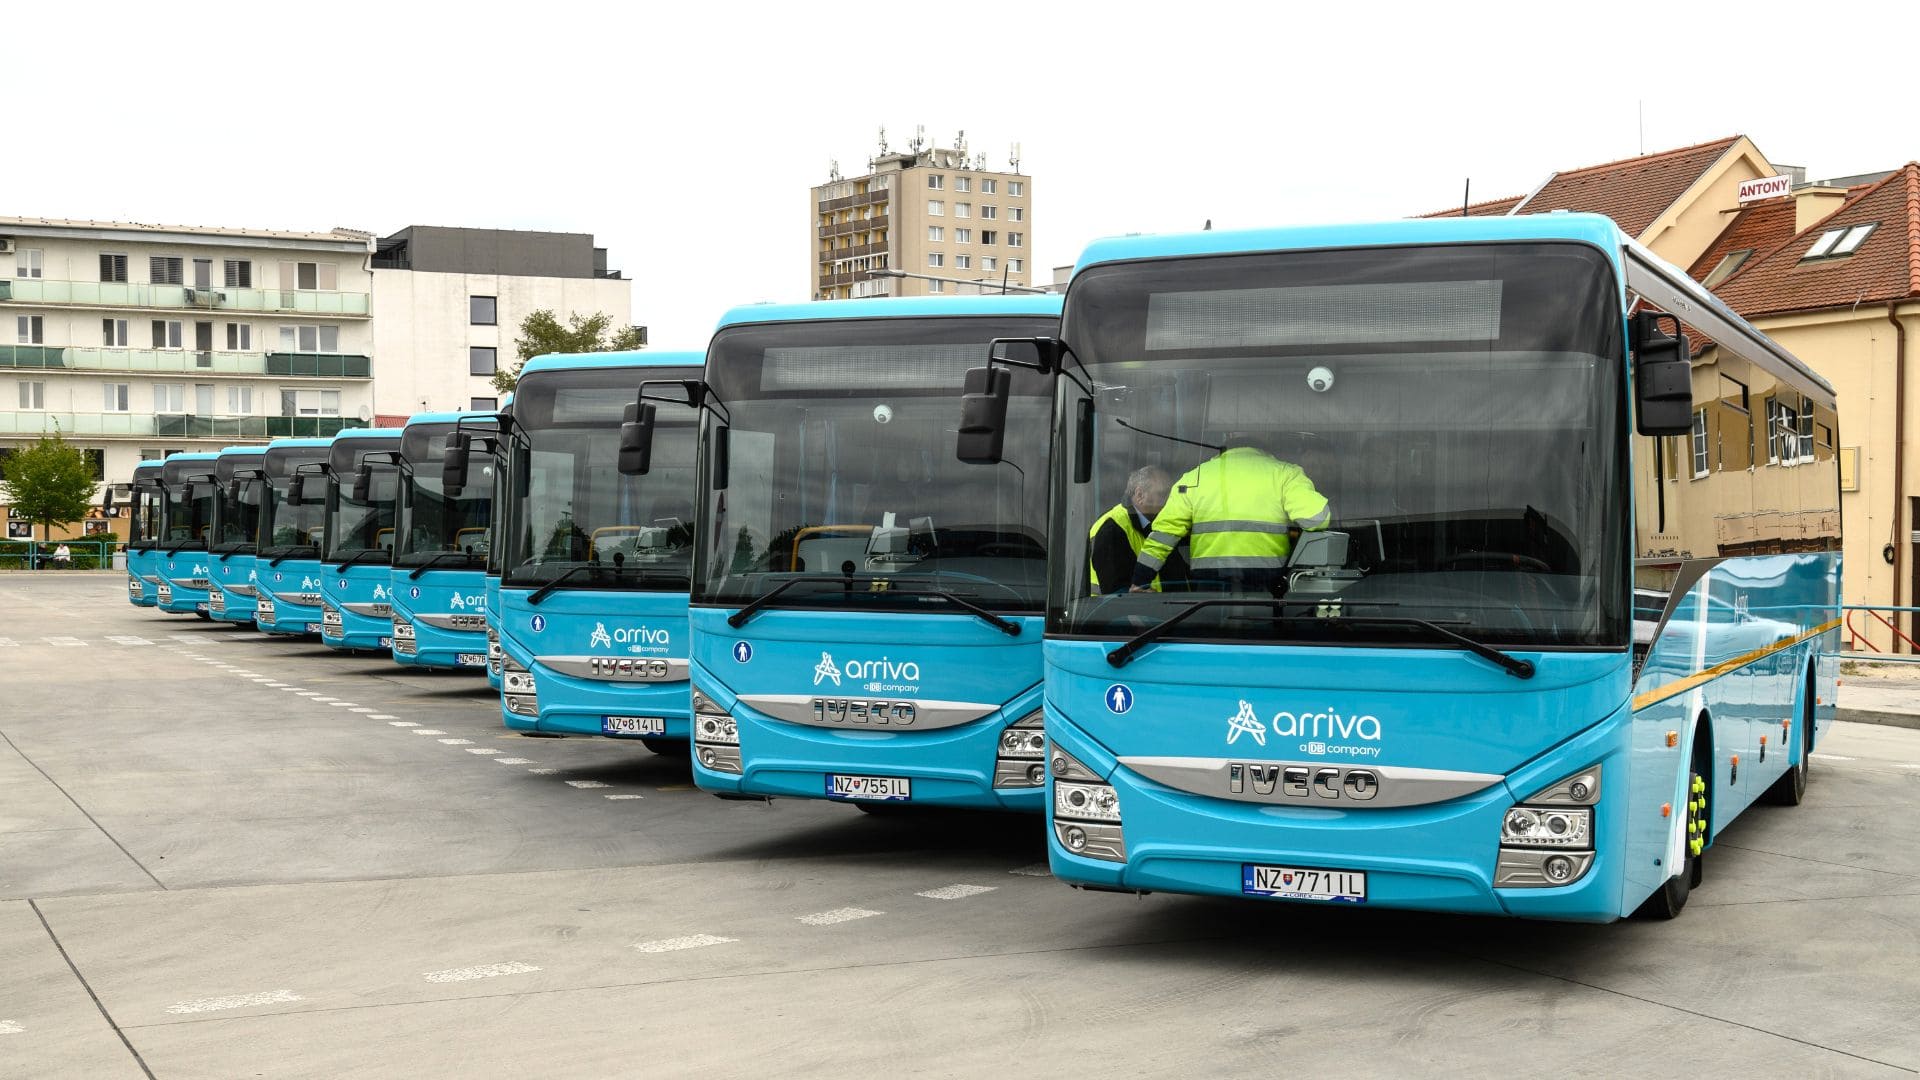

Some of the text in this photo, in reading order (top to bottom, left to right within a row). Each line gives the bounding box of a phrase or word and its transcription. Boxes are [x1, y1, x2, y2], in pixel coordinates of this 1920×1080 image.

[1740, 179, 1788, 198] ANTONY
[614, 626, 669, 644] arriva
[591, 658, 668, 678] IVECO
[846, 656, 919, 681] arriva
[882, 684, 919, 694] company
[814, 699, 916, 726] IVECO
[608, 718, 662, 732] NZ 814IL
[1273, 707, 1381, 741] arriva
[1300, 742, 1381, 758] a DB company
[835, 776, 907, 796] NZ 755IL
[1230, 764, 1379, 801] IVECO
[1256, 868, 1361, 895] NZ 771IL
